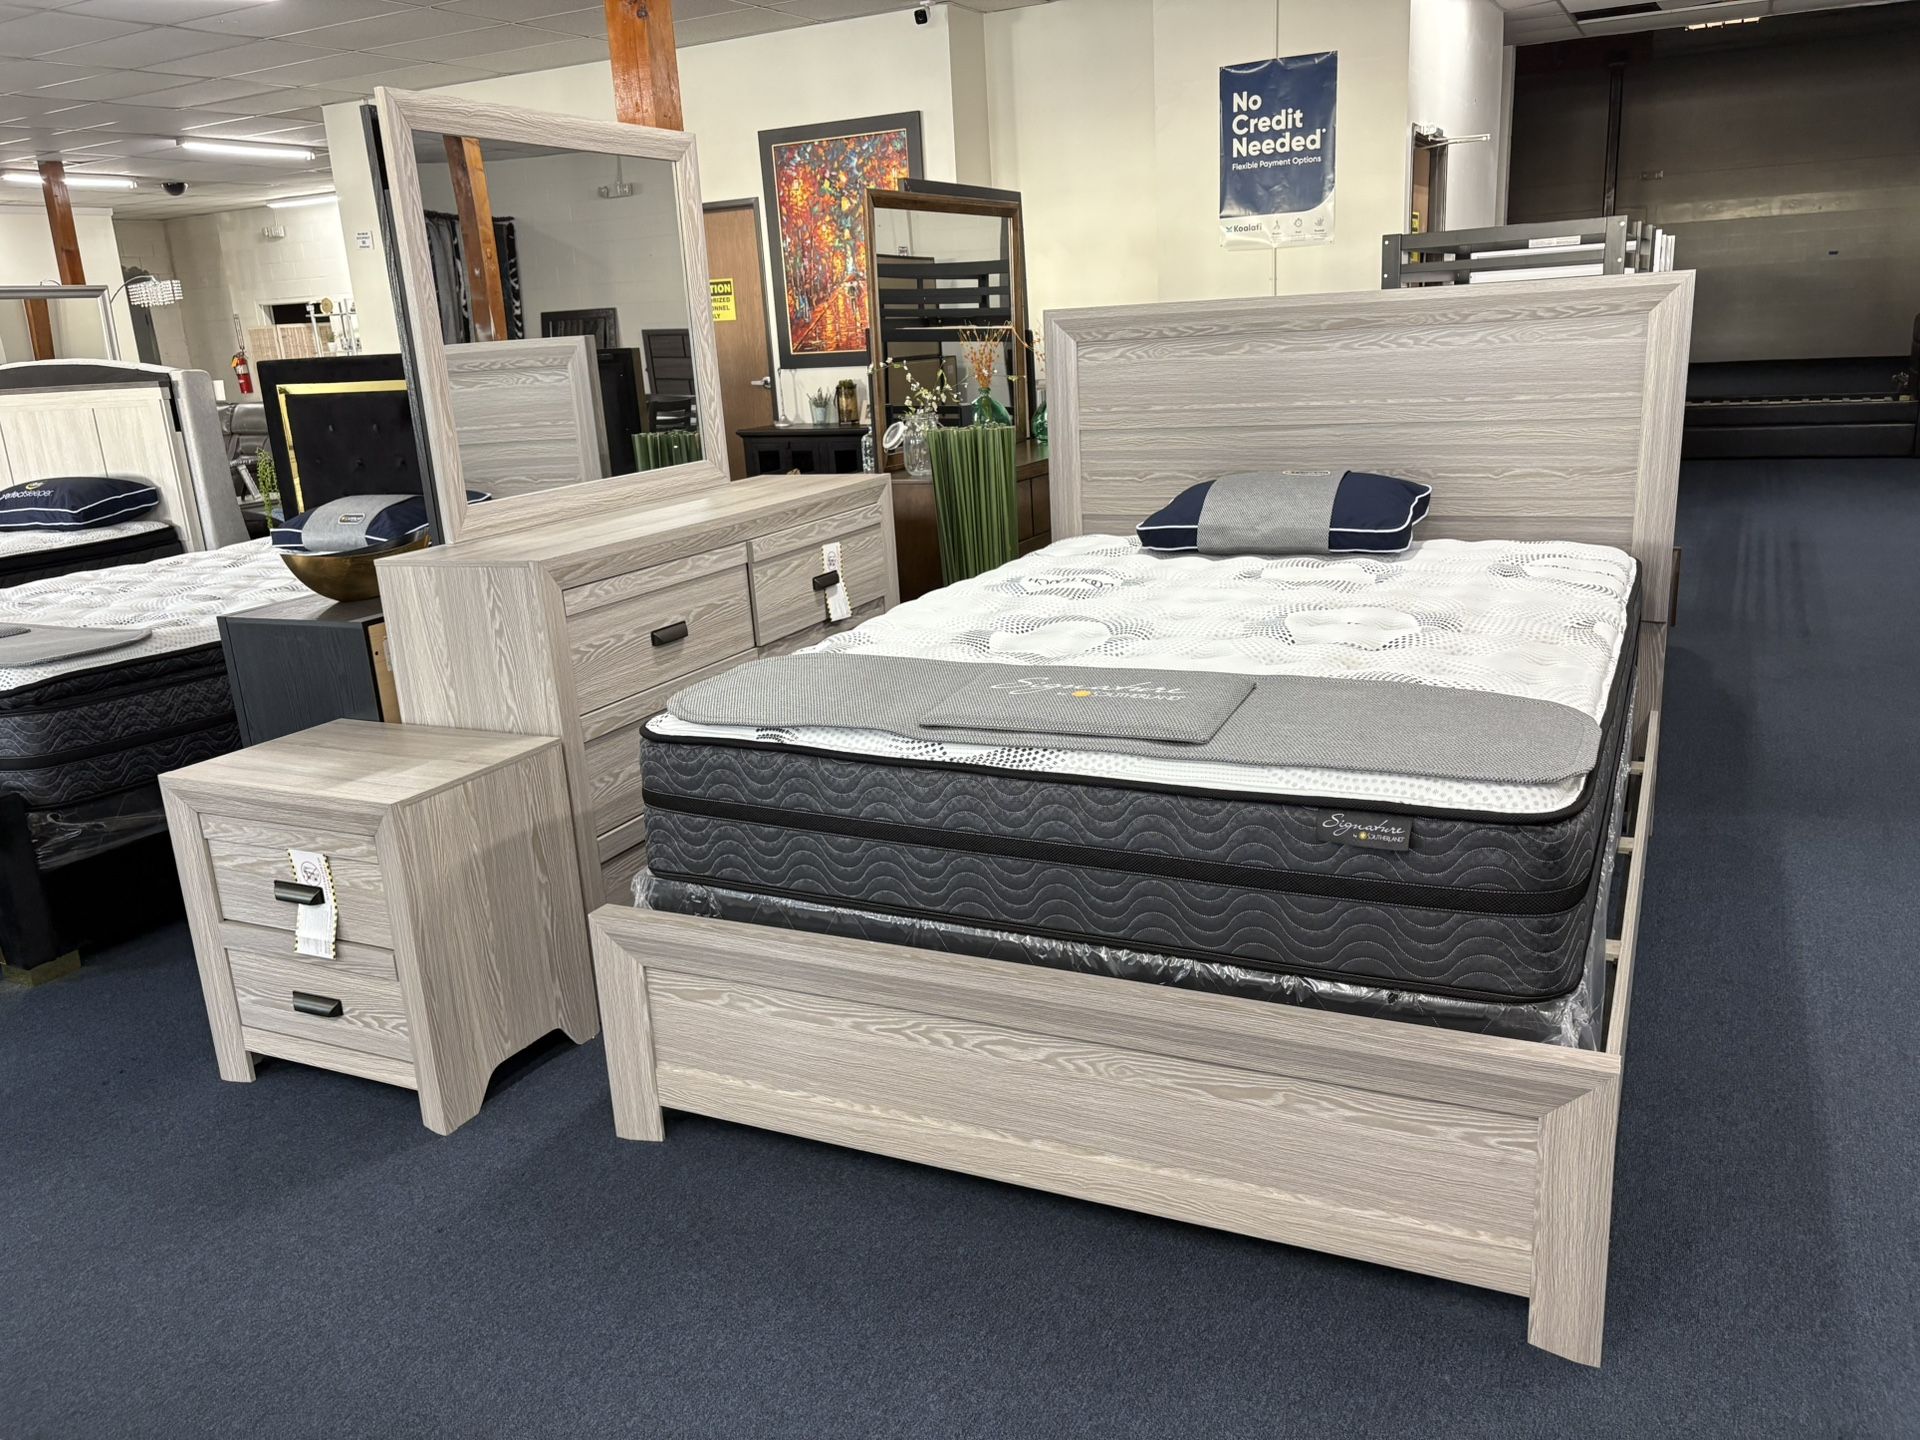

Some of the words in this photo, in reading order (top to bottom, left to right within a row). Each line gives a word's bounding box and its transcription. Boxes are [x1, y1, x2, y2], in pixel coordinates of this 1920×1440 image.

[1233, 91, 1262, 113] No
[1232, 108, 1303, 135] Credit
[1232, 161, 1258, 171] Flexible
[1260, 158, 1291, 169] Payment
[1292, 156, 1322, 166] Options
[709, 283, 731, 293] TION
[991, 677, 1186, 696] Signature
[1322, 813, 1405, 837] Signature
